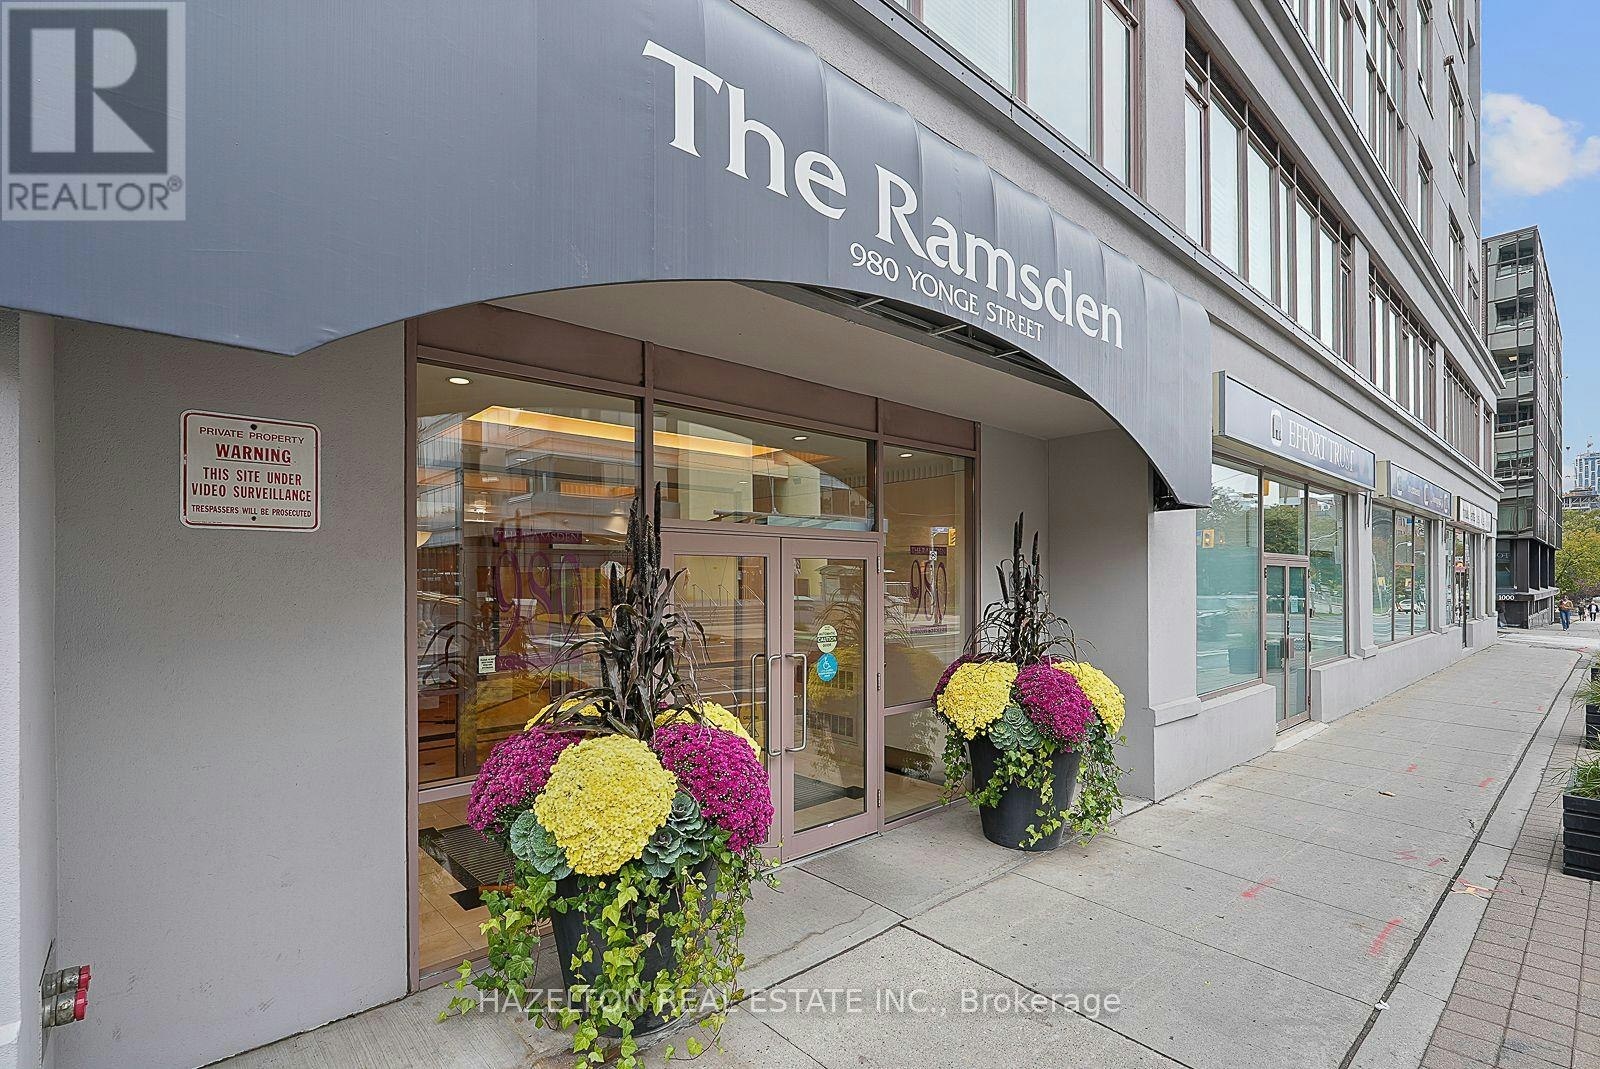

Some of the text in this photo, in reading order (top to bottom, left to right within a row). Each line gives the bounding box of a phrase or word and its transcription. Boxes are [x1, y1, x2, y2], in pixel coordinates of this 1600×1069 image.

[642, 40, 1123, 350] The Ramsden
[850, 243, 1044, 342] 980 YONGE STREET
[199, 426, 305, 445] PRIVATE PROPERTY
[215, 443, 291, 464] WARNING
[1288, 420, 1355, 472] EFFORT TRUST
[203, 466, 302, 486] THIS SITE UNDER
[191, 482, 312, 502] VIDEO SURVEILLANCE
[191, 504, 312, 518] TRESPASSERS WILL BE PROSECUTED
